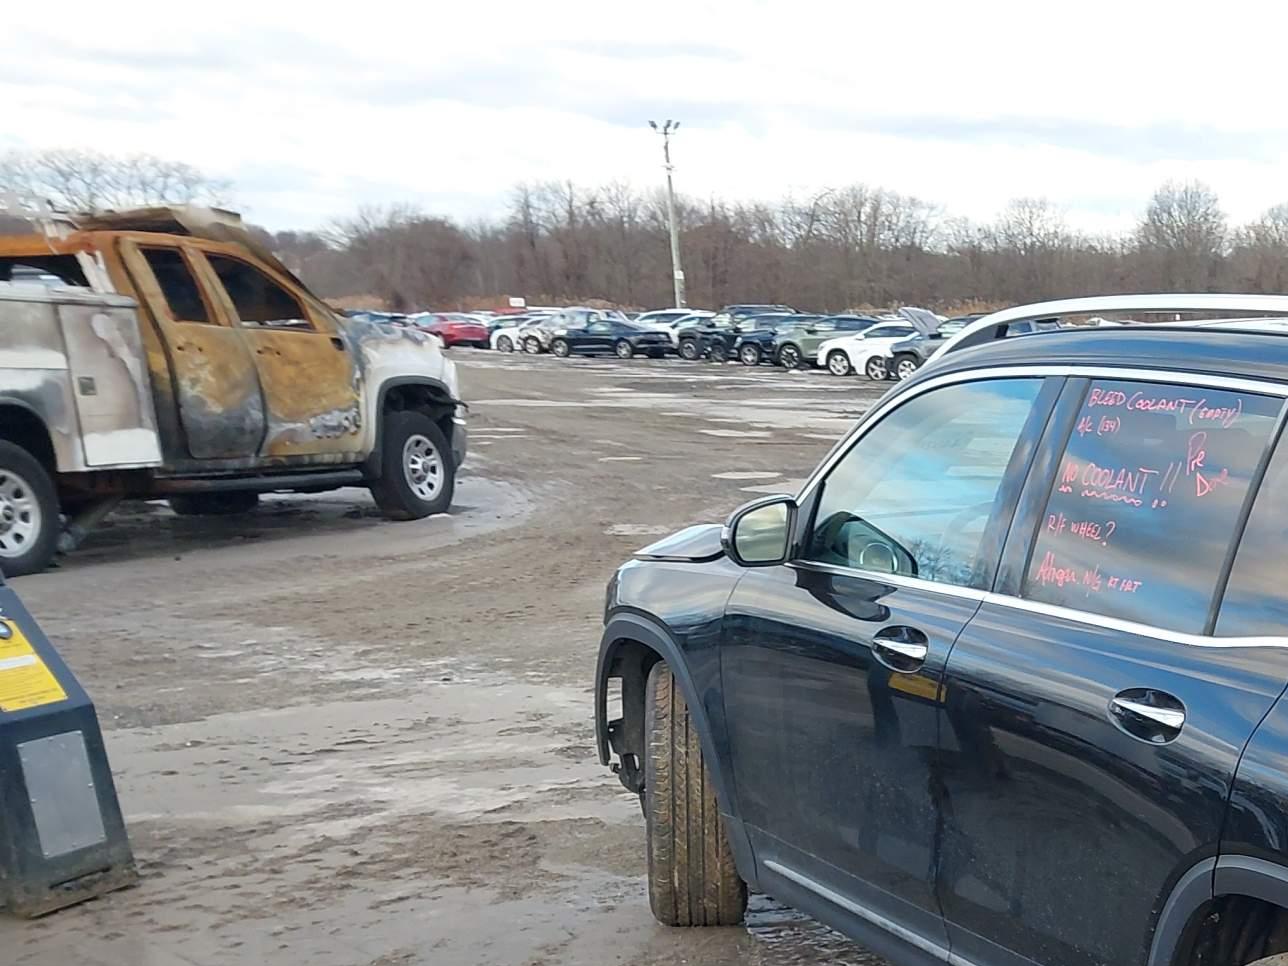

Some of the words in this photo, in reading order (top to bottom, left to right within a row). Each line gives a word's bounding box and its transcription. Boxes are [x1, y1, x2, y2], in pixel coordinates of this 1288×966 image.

[1088, 388, 1126, 407] BLEED
[1127, 391, 1196, 413] COOLANT
[1082, 462, 1159, 495] COOLANT
